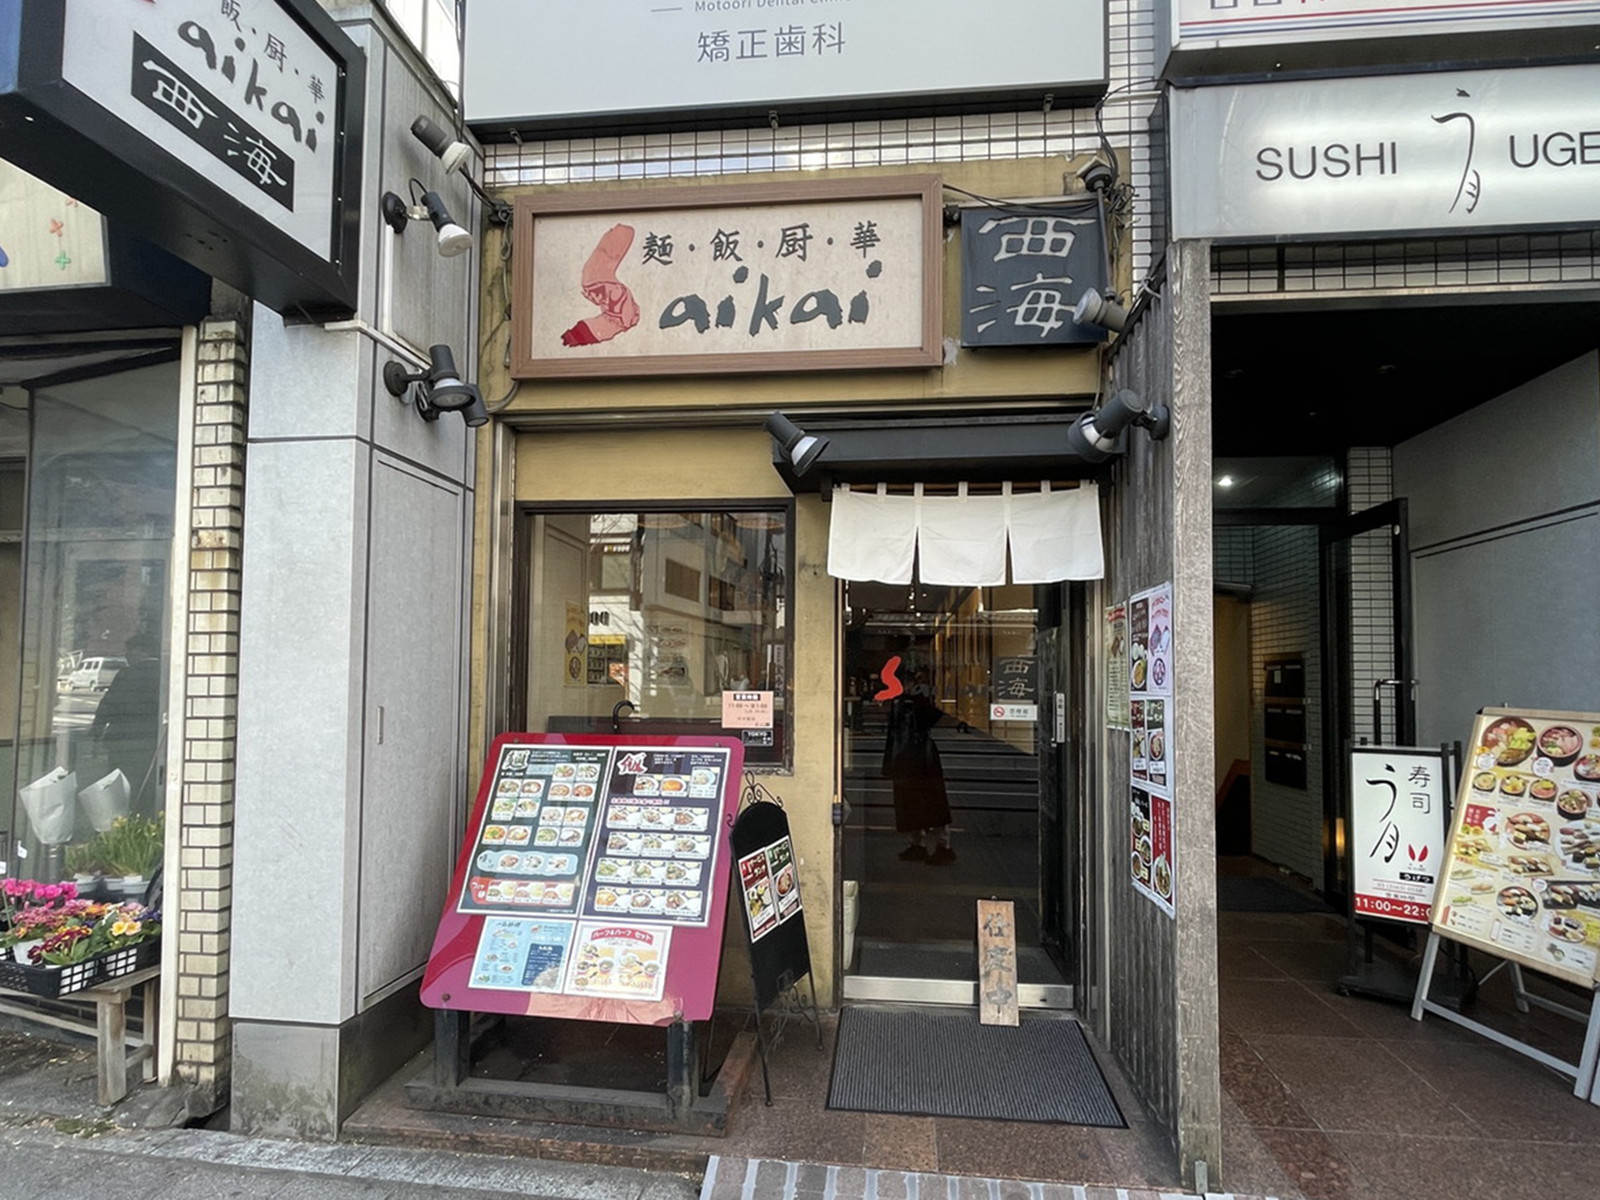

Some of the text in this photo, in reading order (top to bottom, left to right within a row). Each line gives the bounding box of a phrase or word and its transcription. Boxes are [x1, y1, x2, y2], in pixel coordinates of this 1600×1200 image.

[697, 22, 846, 63] 矯正歯科
[142, 59, 287, 186] 西海
[1256, 142, 1398, 181] SUSHI
[969, 216, 1098, 337] 西海
[1408, 765, 1431, 814] 寿司
